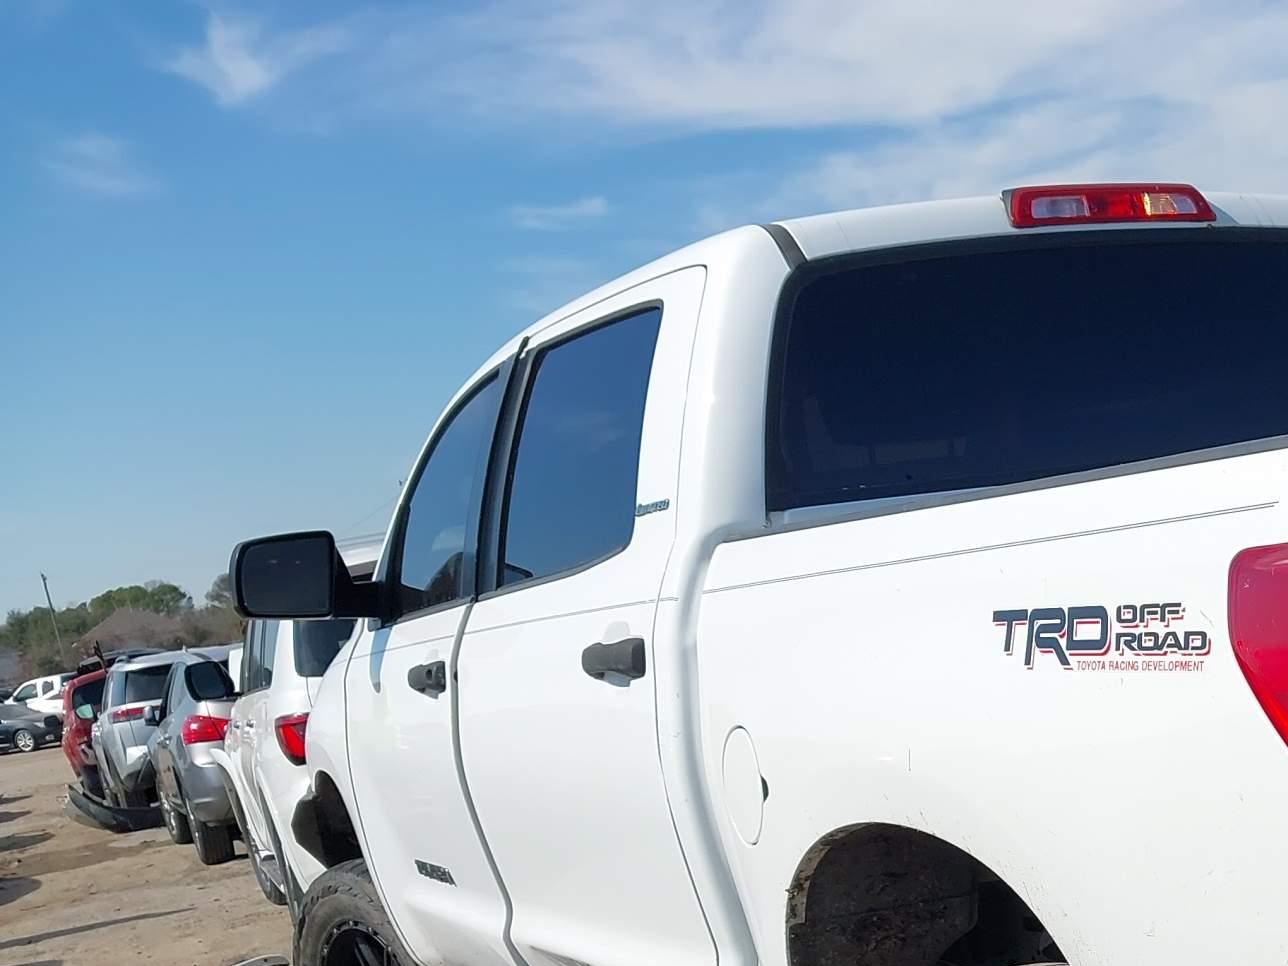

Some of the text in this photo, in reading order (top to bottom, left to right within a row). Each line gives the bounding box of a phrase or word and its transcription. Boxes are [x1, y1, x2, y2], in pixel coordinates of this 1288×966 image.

[1115, 602, 1185, 628] OFF
[993, 605, 1111, 670] TRD
[1115, 631, 1211, 656] ROAD
[1076, 660, 1205, 672] TOYOTA RACING DEVELOPMENT
